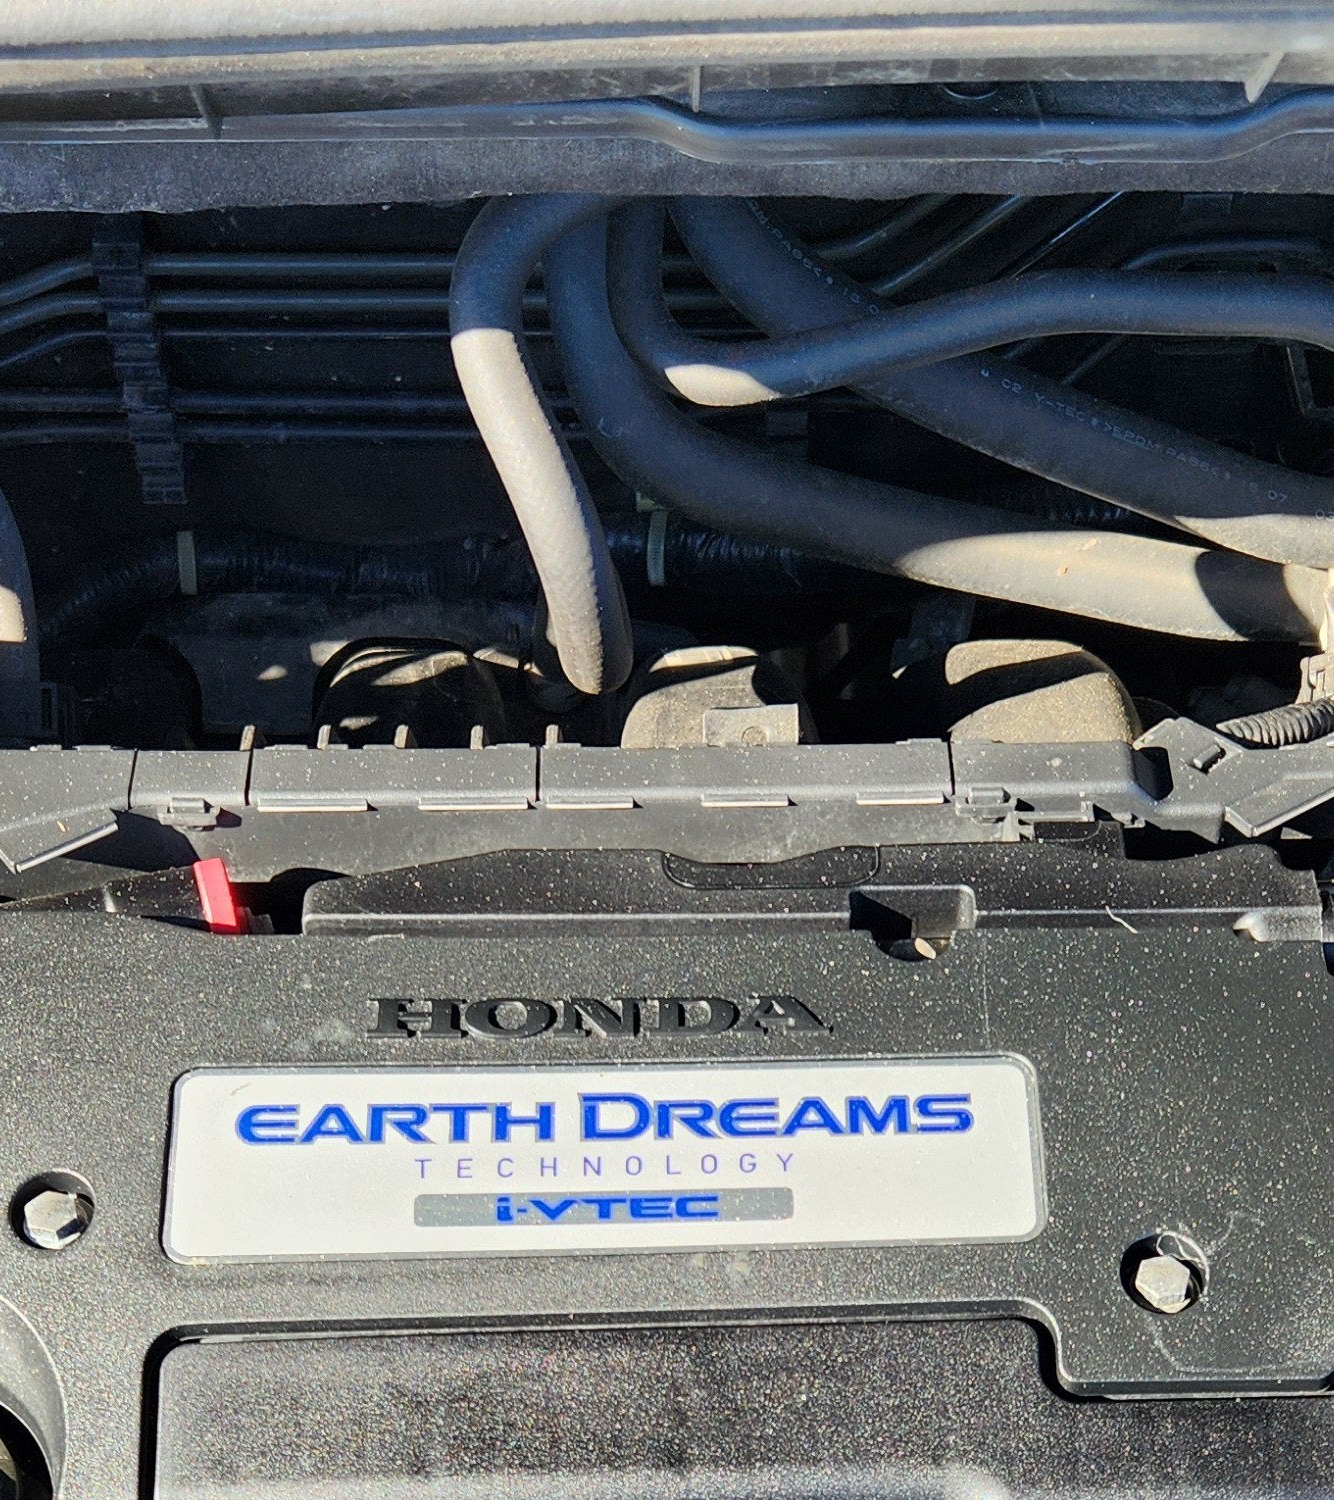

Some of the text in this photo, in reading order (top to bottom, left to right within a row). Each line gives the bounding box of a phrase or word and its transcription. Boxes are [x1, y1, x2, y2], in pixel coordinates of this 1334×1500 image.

[367, 995, 834, 1041] HONDA
[235, 1091, 974, 1146] EARTH DREAMS
[414, 1153, 797, 1180] TECHNOLOGY
[495, 1194, 721, 1222] i-VTEC
